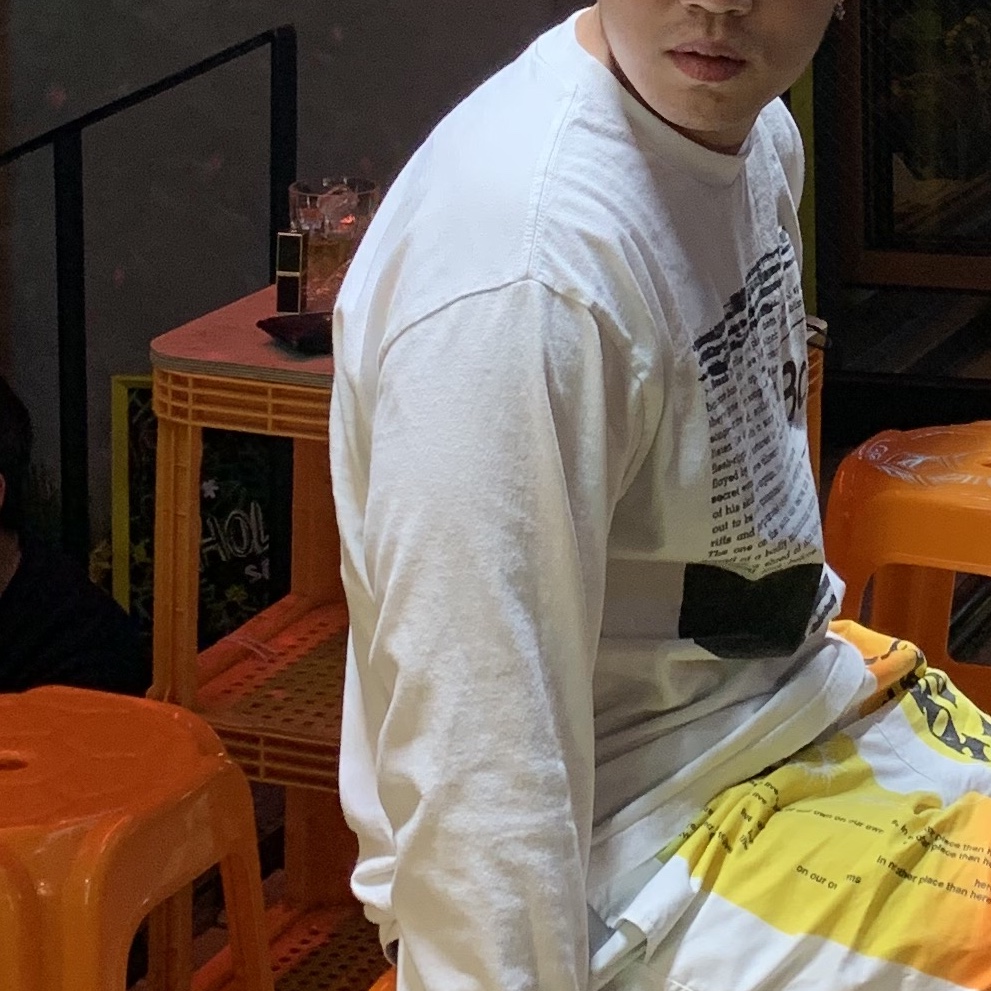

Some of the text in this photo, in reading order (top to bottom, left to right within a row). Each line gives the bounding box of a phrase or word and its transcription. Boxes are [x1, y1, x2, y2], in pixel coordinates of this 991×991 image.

[796, 864, 808, 876] on
[810, 872, 828, 885] our
[918, 875, 944, 889] place
[946, 880, 968, 895] than
